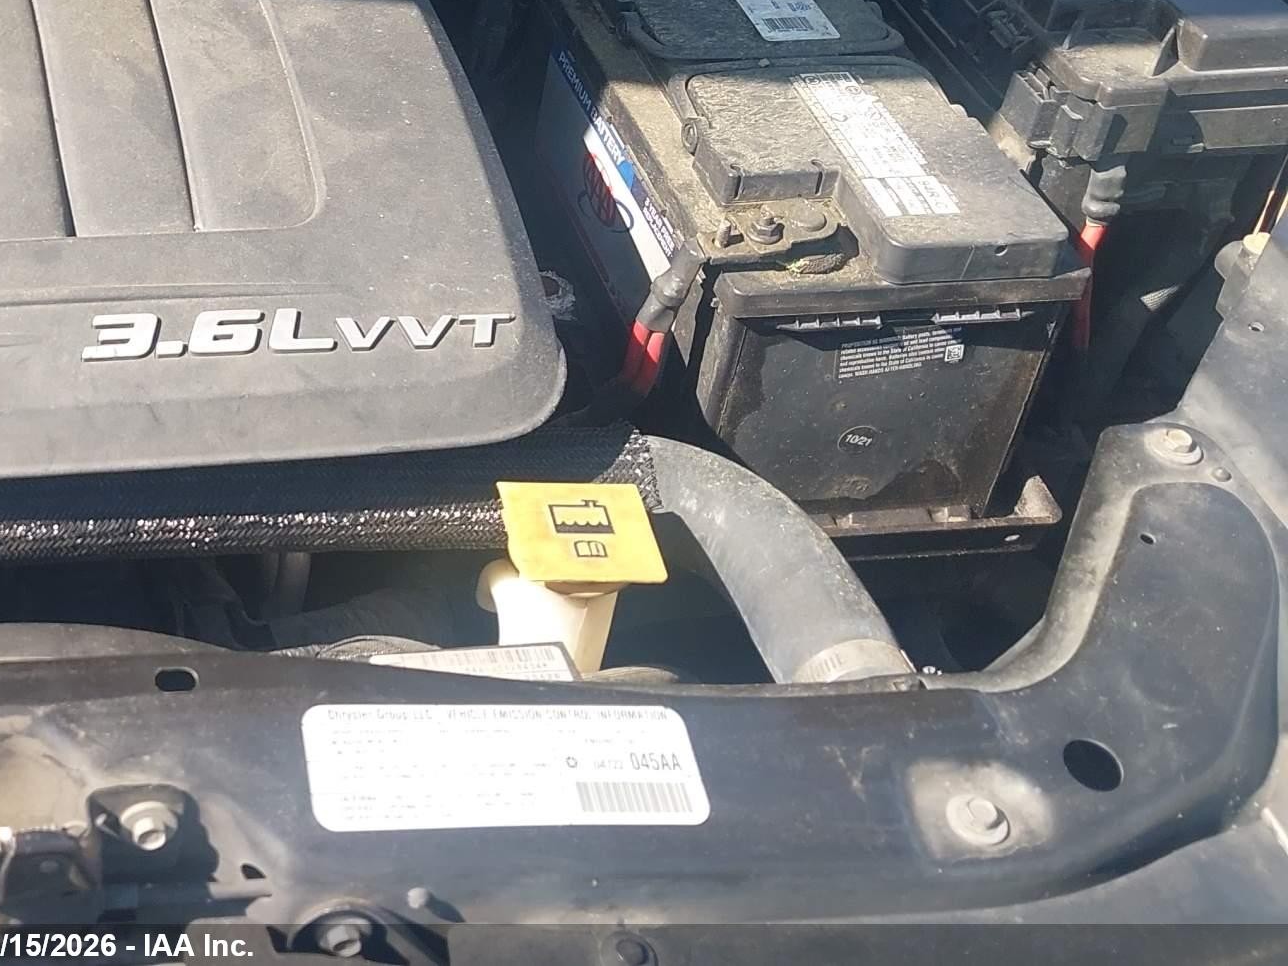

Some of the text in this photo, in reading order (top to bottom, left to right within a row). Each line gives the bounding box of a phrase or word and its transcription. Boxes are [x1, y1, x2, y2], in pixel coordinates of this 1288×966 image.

[558, 53, 626, 166] PREMIUM BATTERY
[81, 307, 517, 363] 3.6L VVT
[845, 433, 873, 447] 10/21
[629, 752, 682, 771] 045AA
